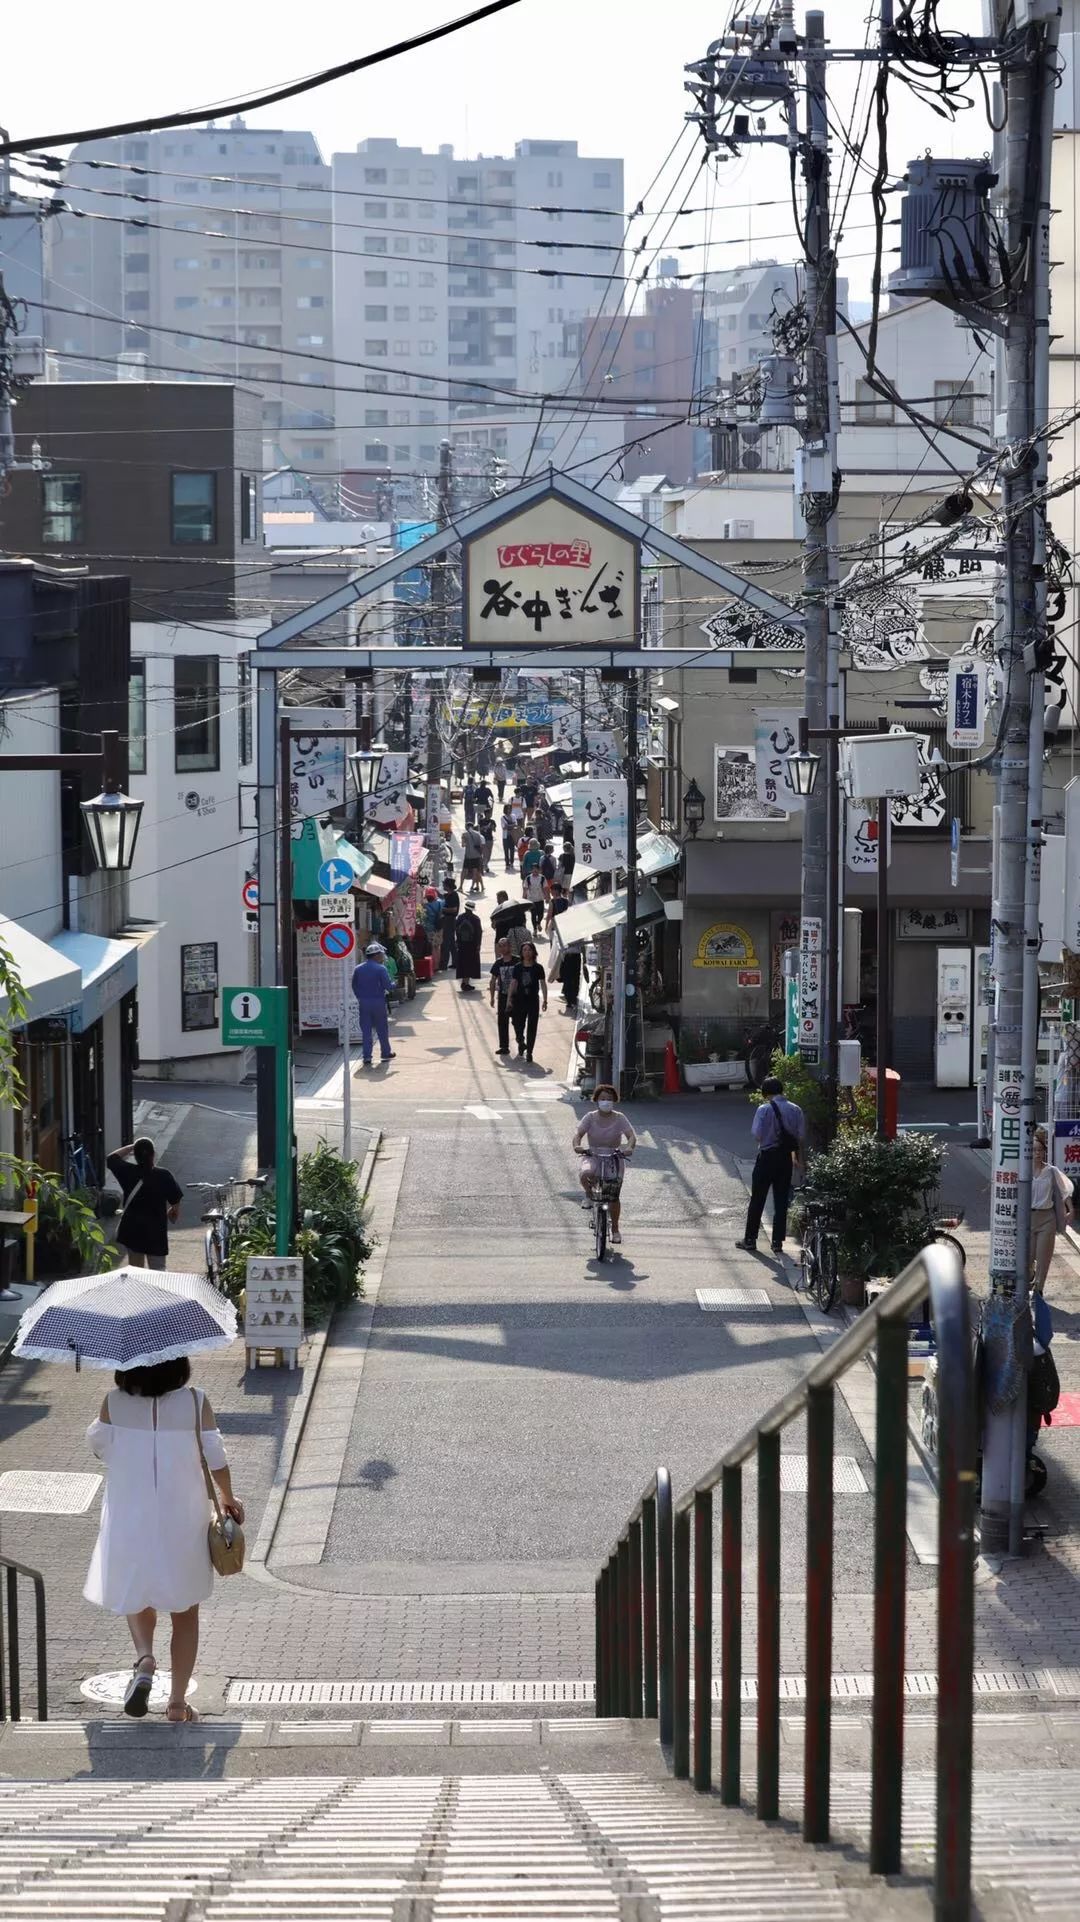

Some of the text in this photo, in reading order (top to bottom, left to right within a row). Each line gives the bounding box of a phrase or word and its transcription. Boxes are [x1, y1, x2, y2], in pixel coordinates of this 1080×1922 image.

[499, 539, 590, 568] ひぐらしの里
[480, 562, 624, 632] 谷中ぎんざ
[961, 678, 972, 725] 宿木カフェ
[765, 778, 777, 802] 祭り
[582, 843, 592, 864] 祭り
[321, 905, 352, 913] 一方通行
[1000, 1118, 1020, 1166] 田戸
[270, 1289, 293, 1304] LA
[249, 1311, 299, 1327] PAPA
